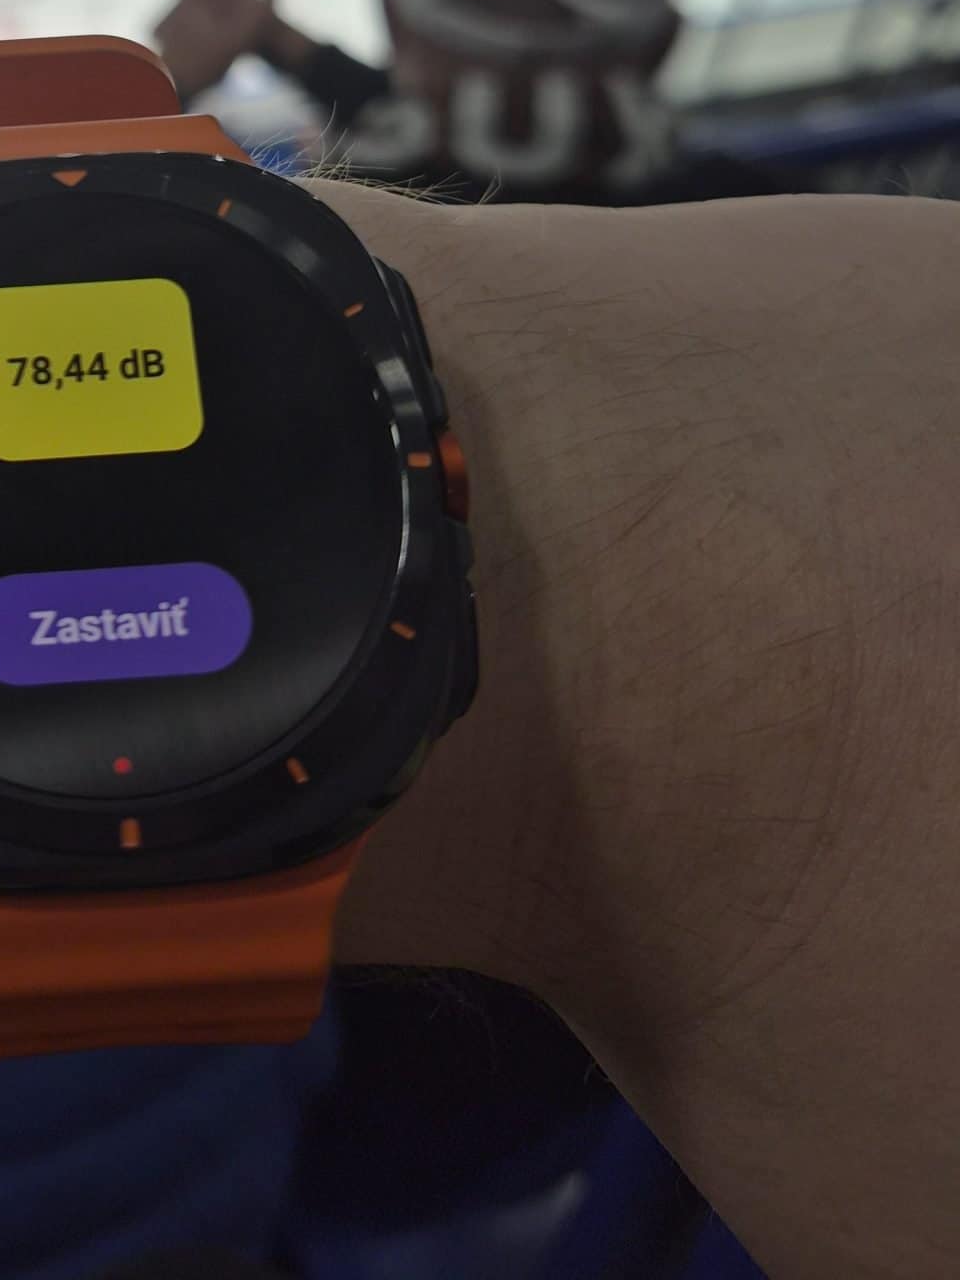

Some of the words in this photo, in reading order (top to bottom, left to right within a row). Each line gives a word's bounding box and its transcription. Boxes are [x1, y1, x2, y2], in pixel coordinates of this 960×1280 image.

[6, 352, 109, 390] 78,44
[119, 348, 166, 379] dB
[28, 596, 190, 646] Zastaviť
